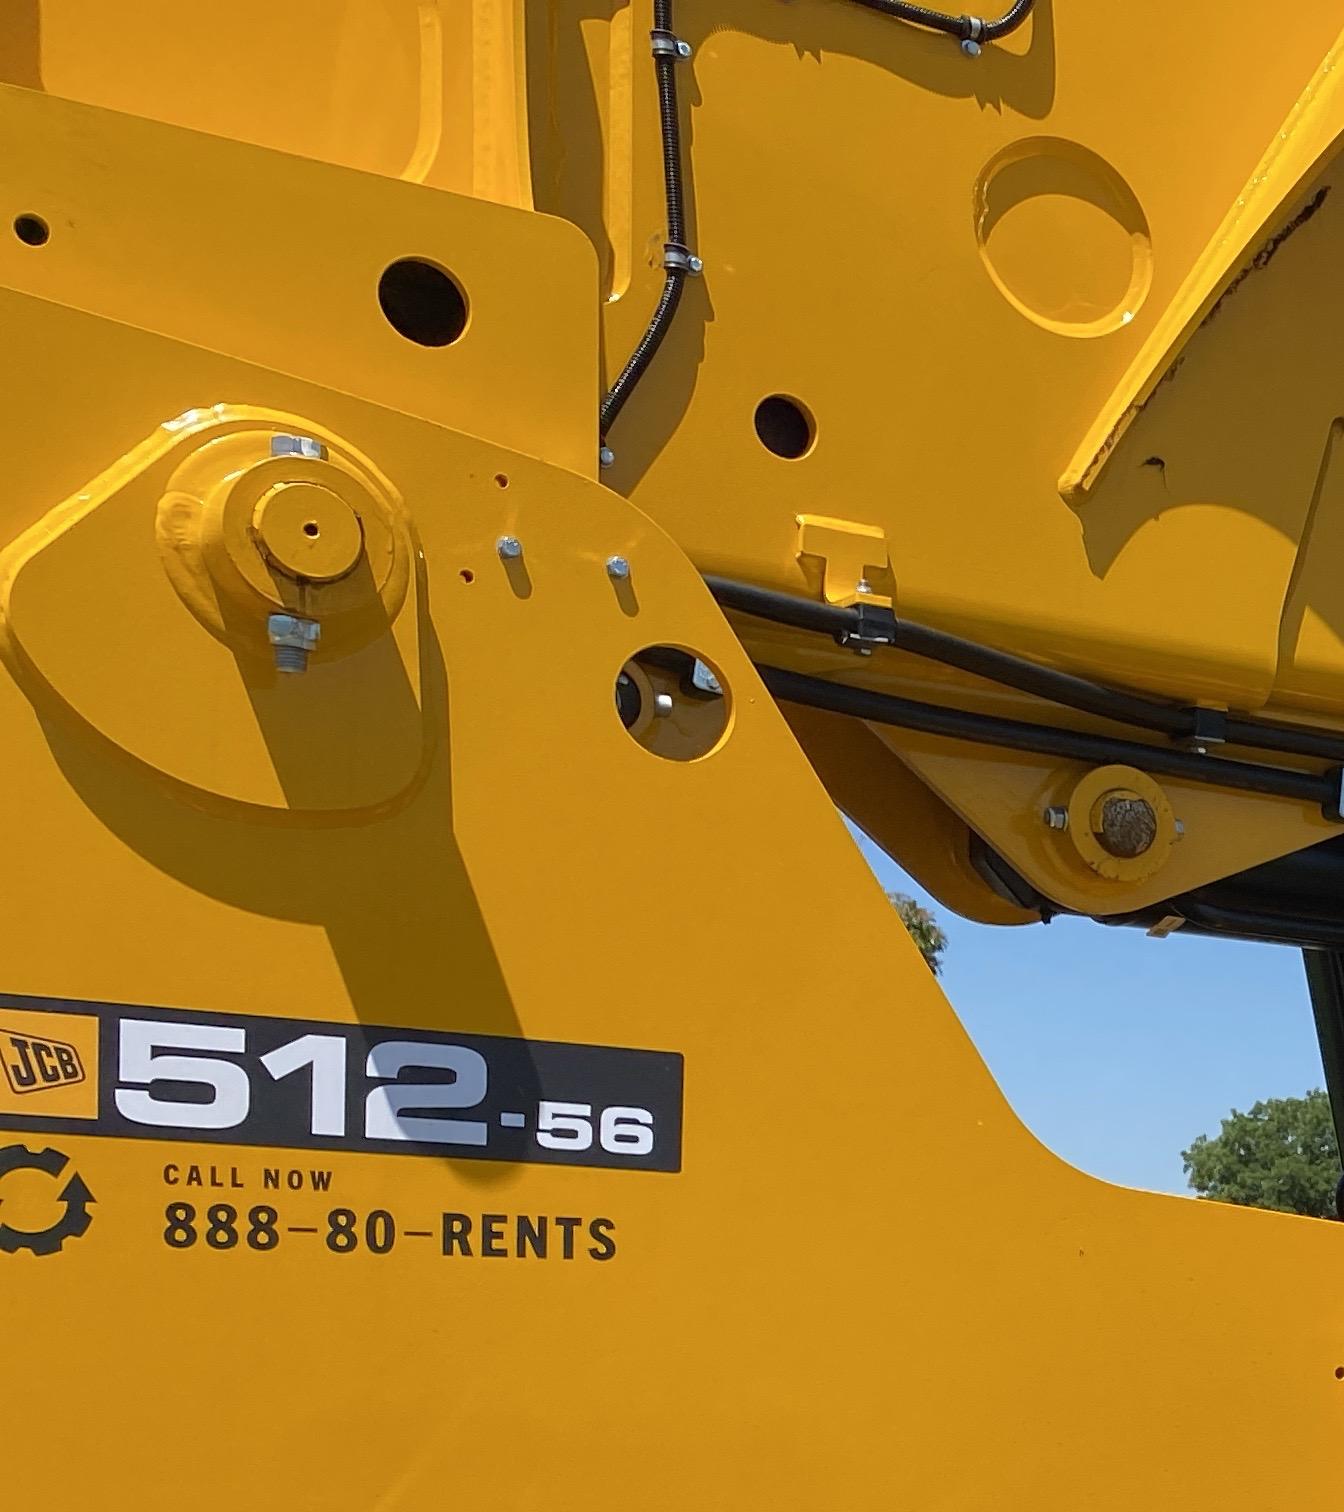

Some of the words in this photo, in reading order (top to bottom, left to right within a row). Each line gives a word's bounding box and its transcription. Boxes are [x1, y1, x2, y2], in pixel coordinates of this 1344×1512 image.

[9, 1036, 79, 1087] JCB
[113, 1018, 655, 1156] 512-56
[162, 1164, 244, 1188] CALL
[263, 1168, 333, 1192] NOW
[163, 1201, 617, 1261] 888-80-RENTS
